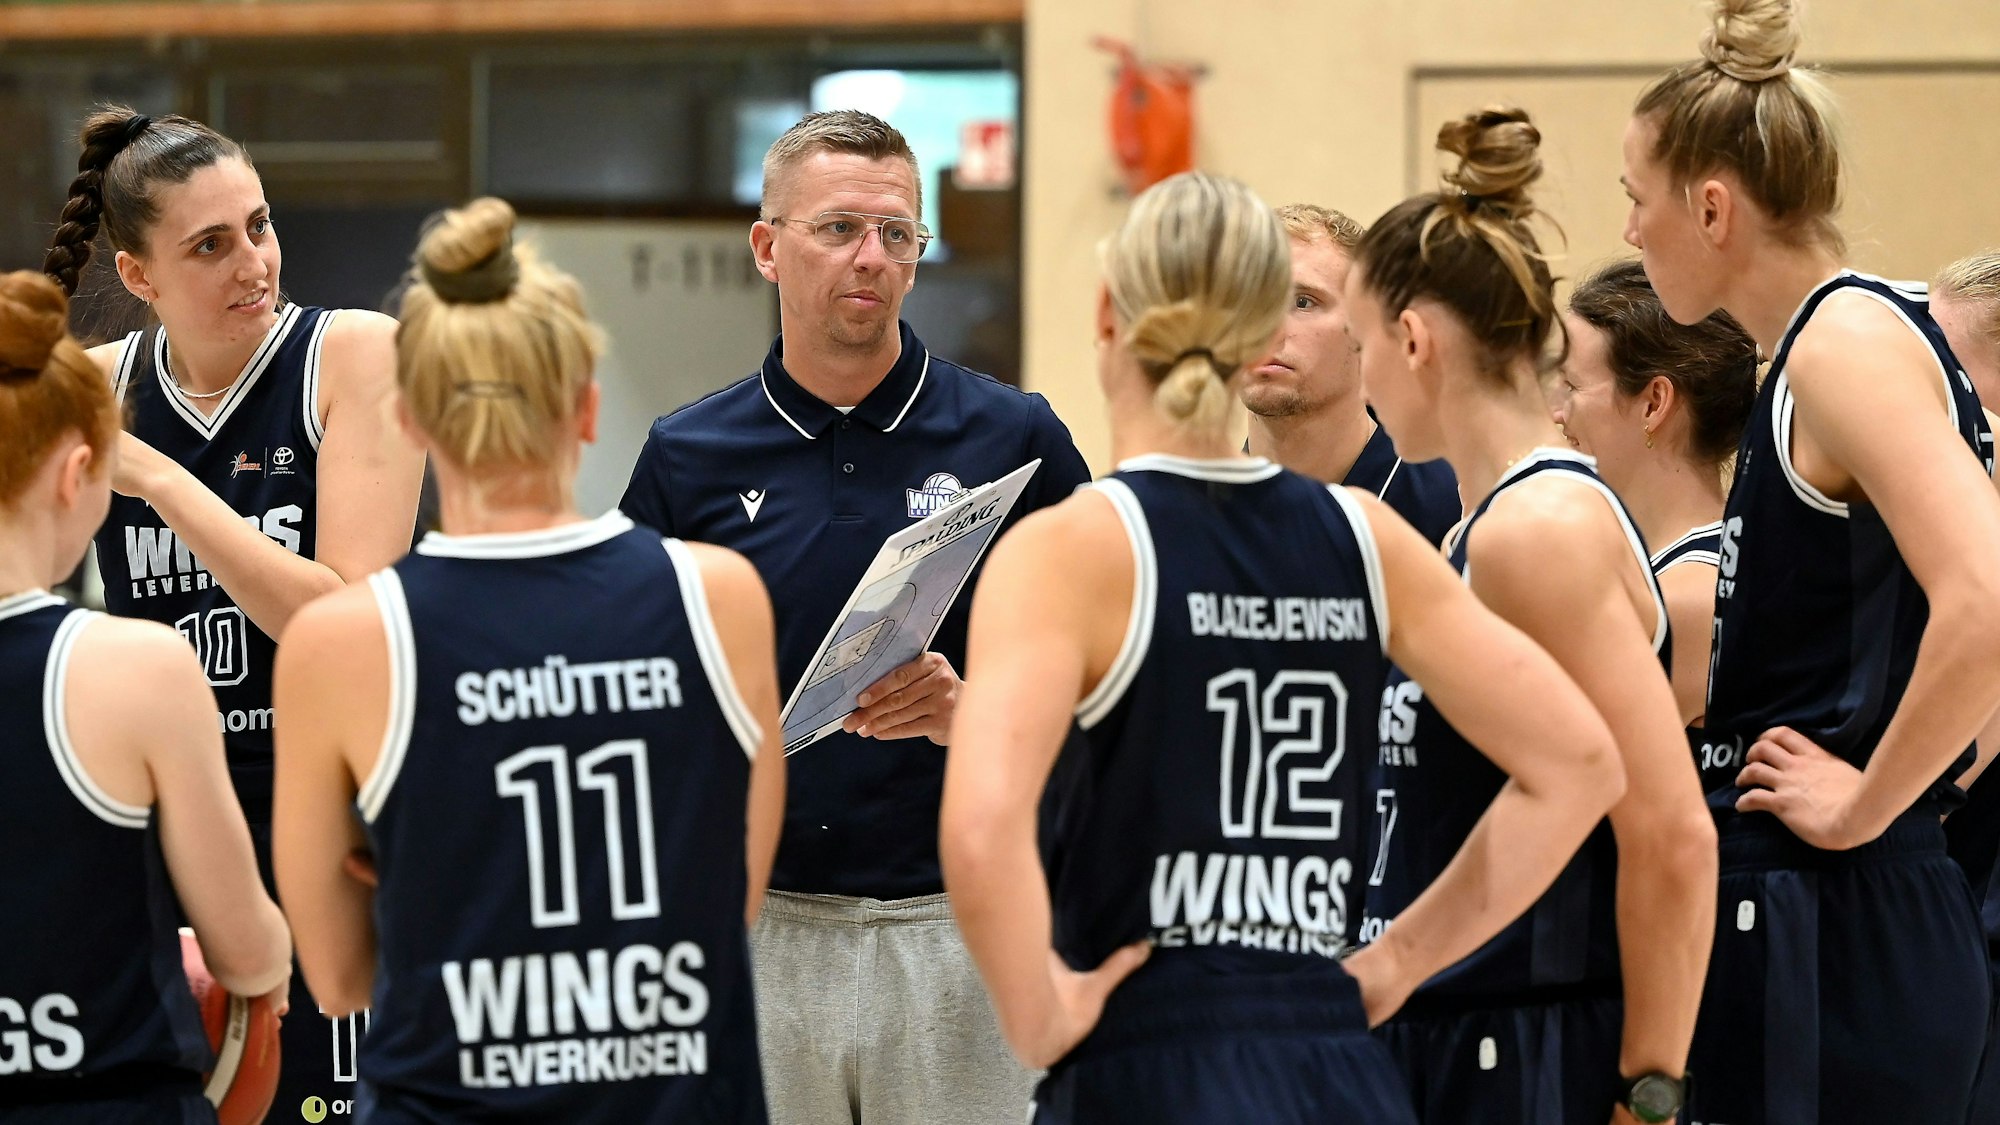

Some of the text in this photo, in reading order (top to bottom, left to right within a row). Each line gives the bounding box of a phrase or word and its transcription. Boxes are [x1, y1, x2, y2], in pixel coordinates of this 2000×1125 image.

[890, 497, 1002, 568] SPALDING
[1186, 593, 1369, 641] BLAZEJEWSKI
[455, 655, 683, 726] SCHÜTTER
[1205, 668, 1348, 840] 12
[494, 738, 661, 929] 11
[1151, 851, 1352, 936] WINGS
[441, 941, 710, 1045] WINGS
[459, 1031, 708, 1089] LEVERKUSEN
